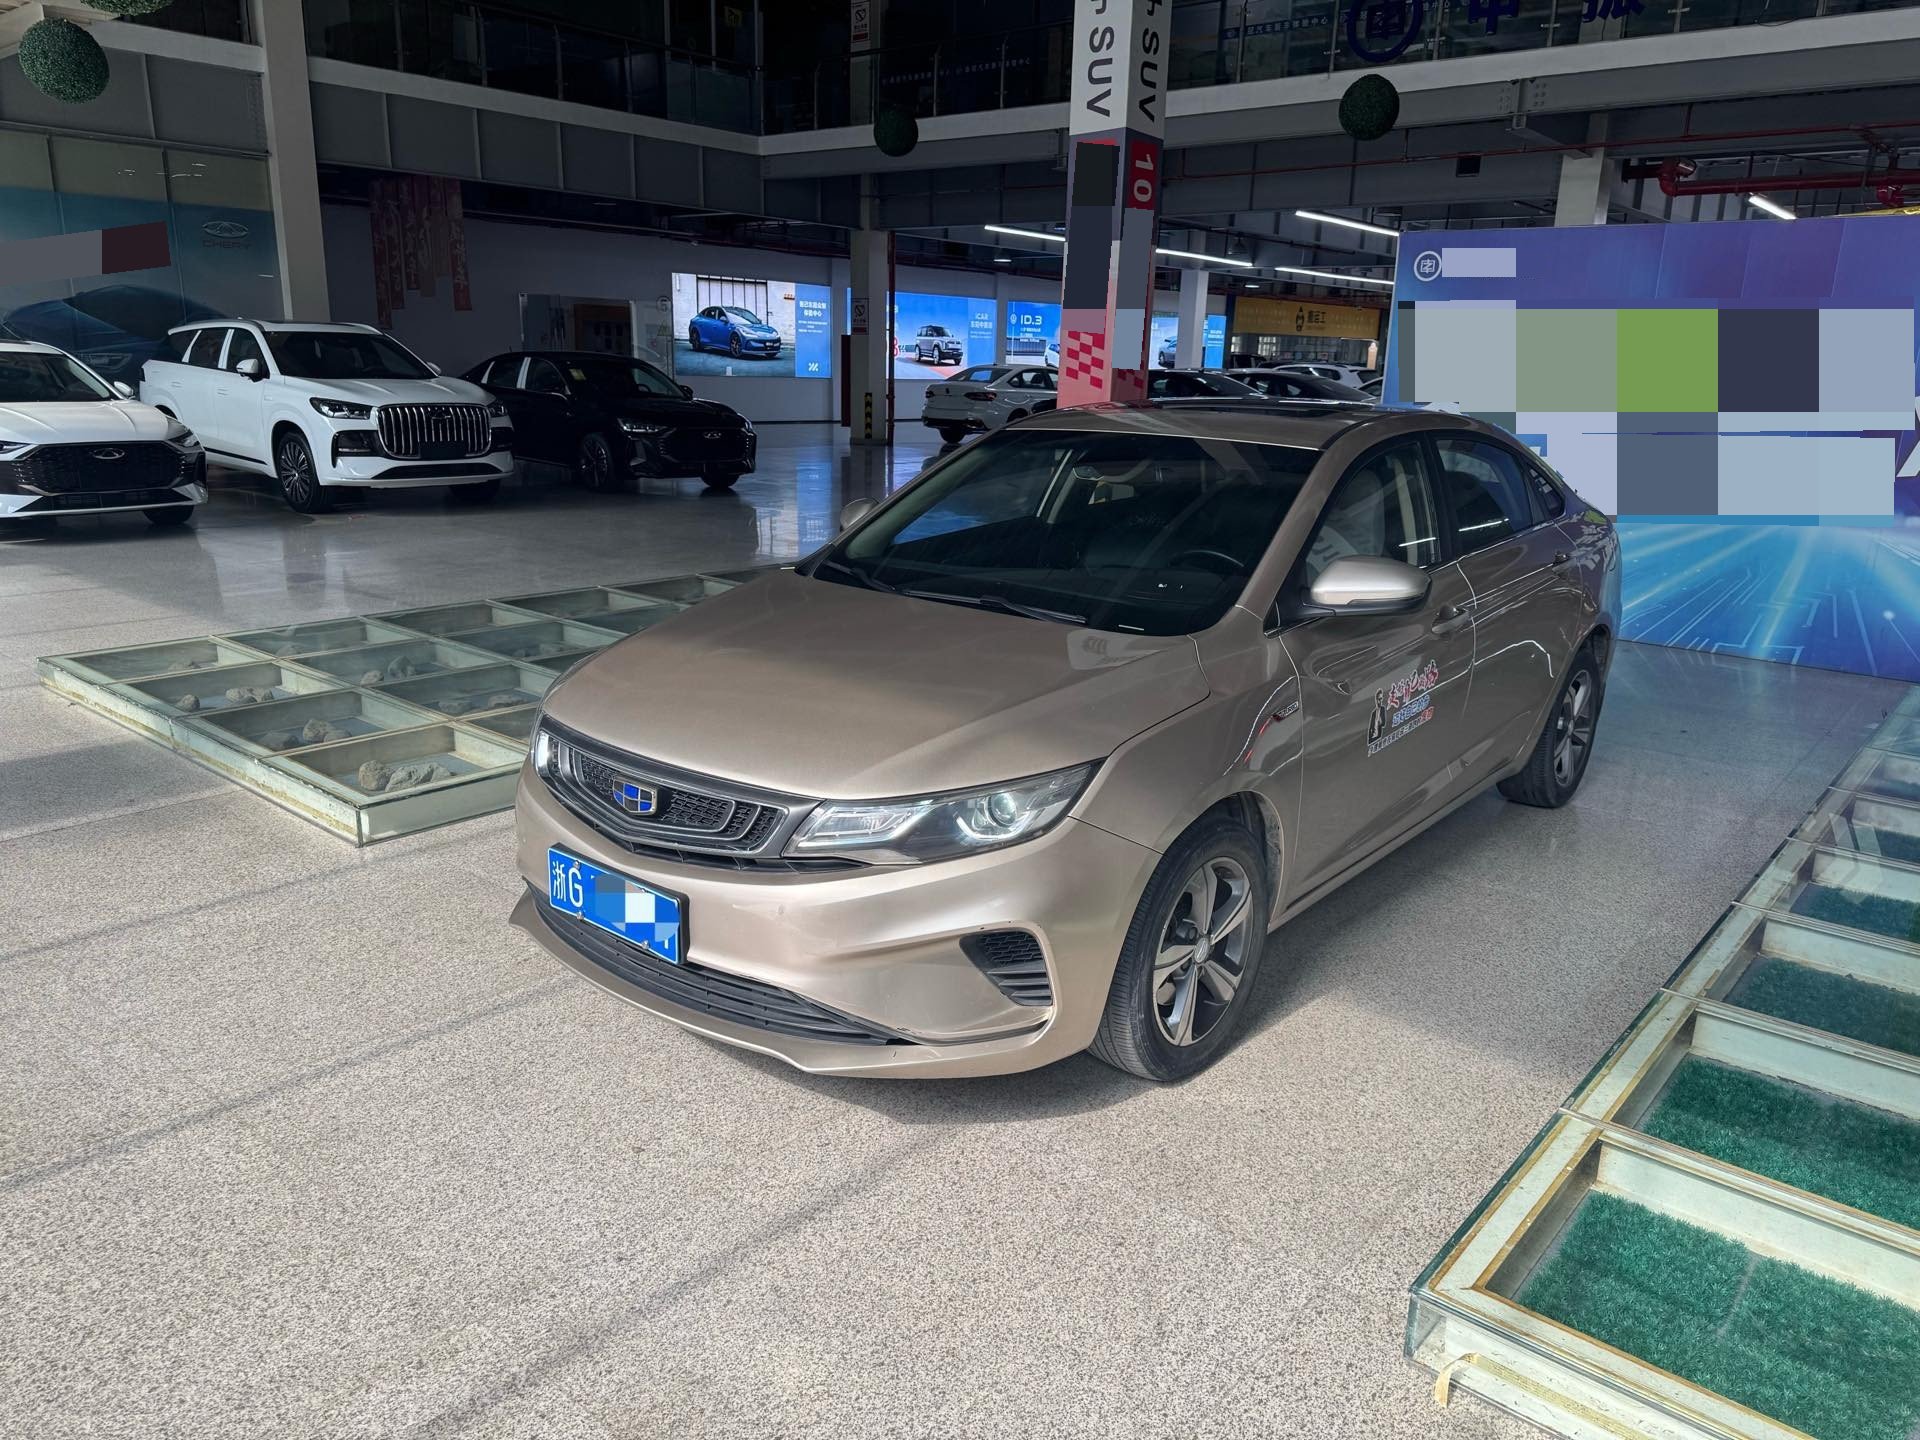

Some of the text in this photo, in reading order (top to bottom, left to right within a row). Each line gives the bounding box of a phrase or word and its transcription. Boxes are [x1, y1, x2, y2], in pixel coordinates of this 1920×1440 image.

[1086, 26, 1115, 118] SUV
[1138, 28, 1160, 123] SUV
[1133, 153, 1154, 202] 10
[1020, 314, 1042, 325] ID.3
[552, 860, 584, 908] 浙G
